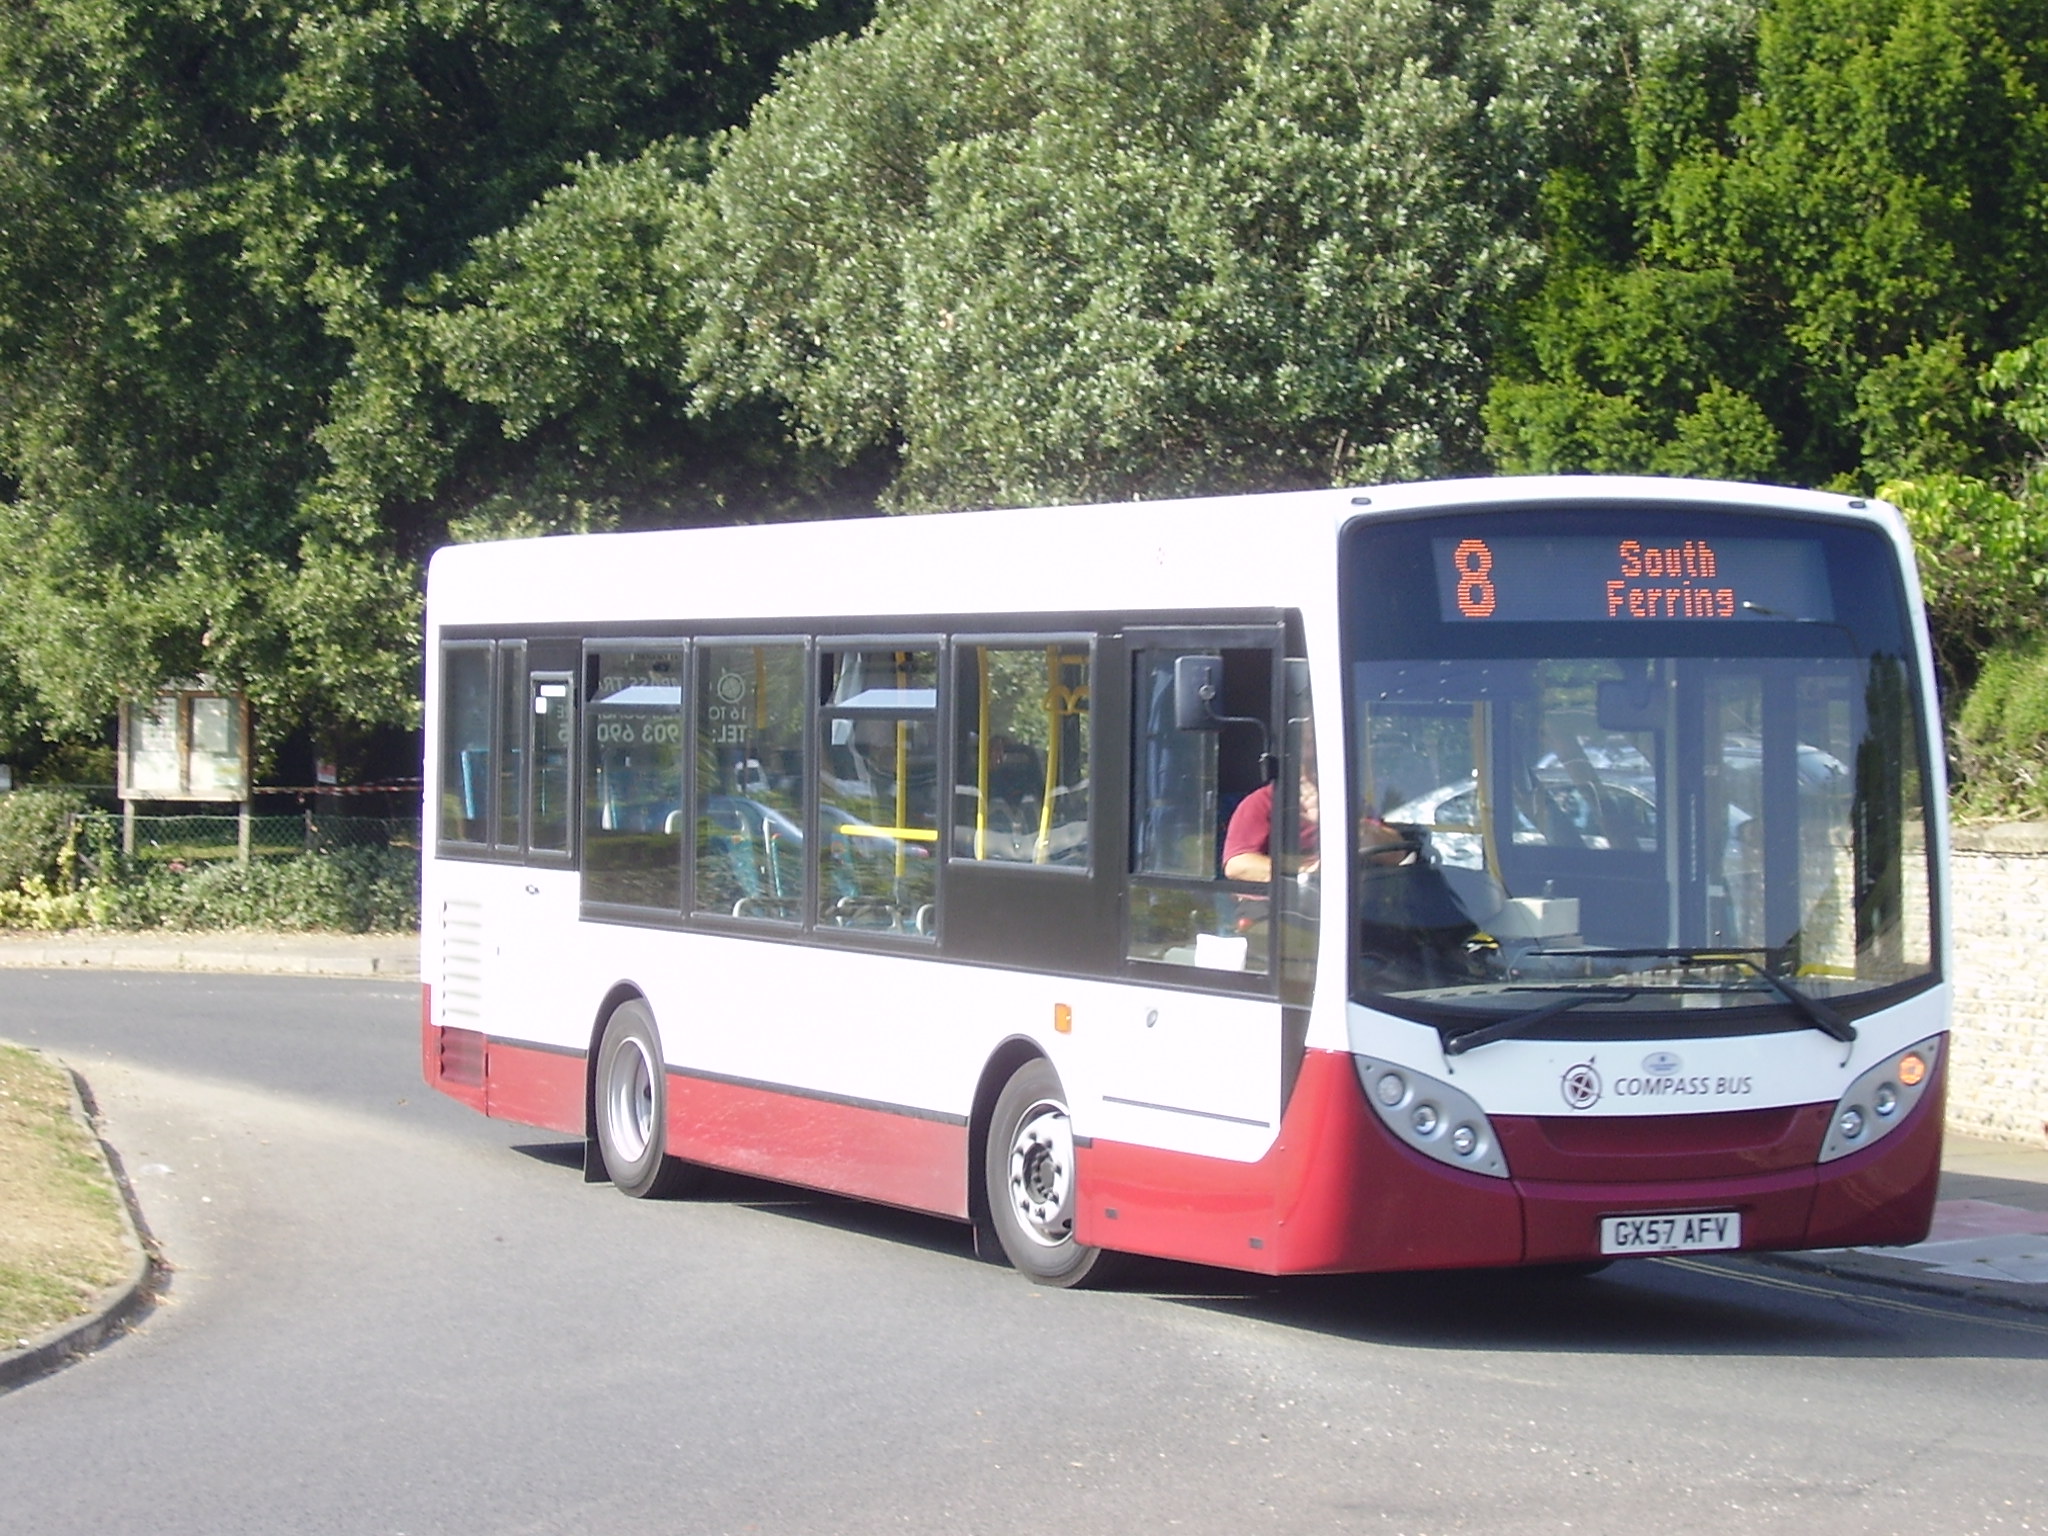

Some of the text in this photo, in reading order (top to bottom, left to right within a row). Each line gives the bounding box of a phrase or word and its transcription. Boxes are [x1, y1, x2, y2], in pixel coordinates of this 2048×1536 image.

[1619, 539, 1716, 577] South
[1453, 539, 1496, 617] 8
[1606, 580, 1735, 617] Ferring
[1613, 1076, 1753, 1096] COMPASS BUS
[1615, 1217, 1728, 1247] GX57 AFV
